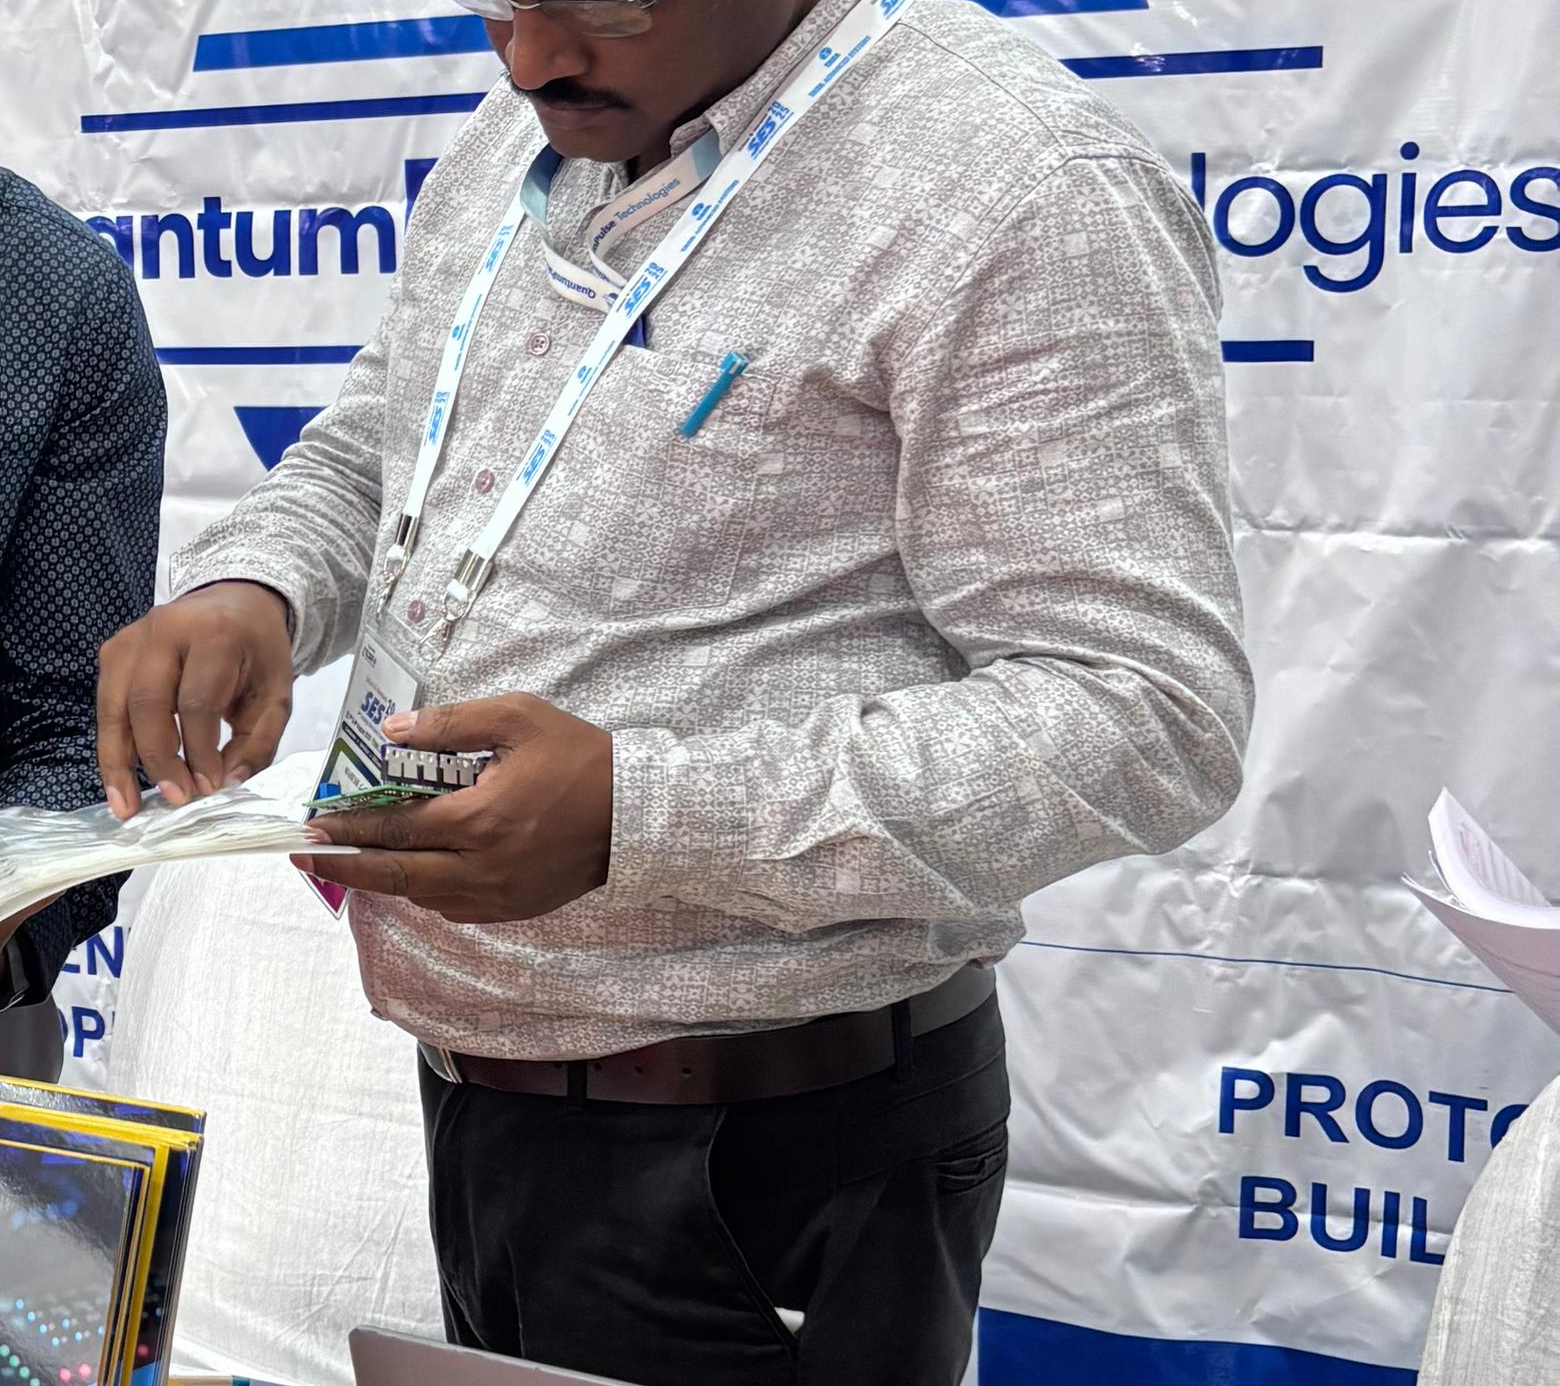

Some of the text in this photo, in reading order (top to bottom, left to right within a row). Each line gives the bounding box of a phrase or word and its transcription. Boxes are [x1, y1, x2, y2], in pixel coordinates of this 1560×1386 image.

[746, 117, 776, 156] SES
[615, 178, 680, 220] Technologies
[625, 276, 651, 315] SES
[361, 691, 385, 725] SES
